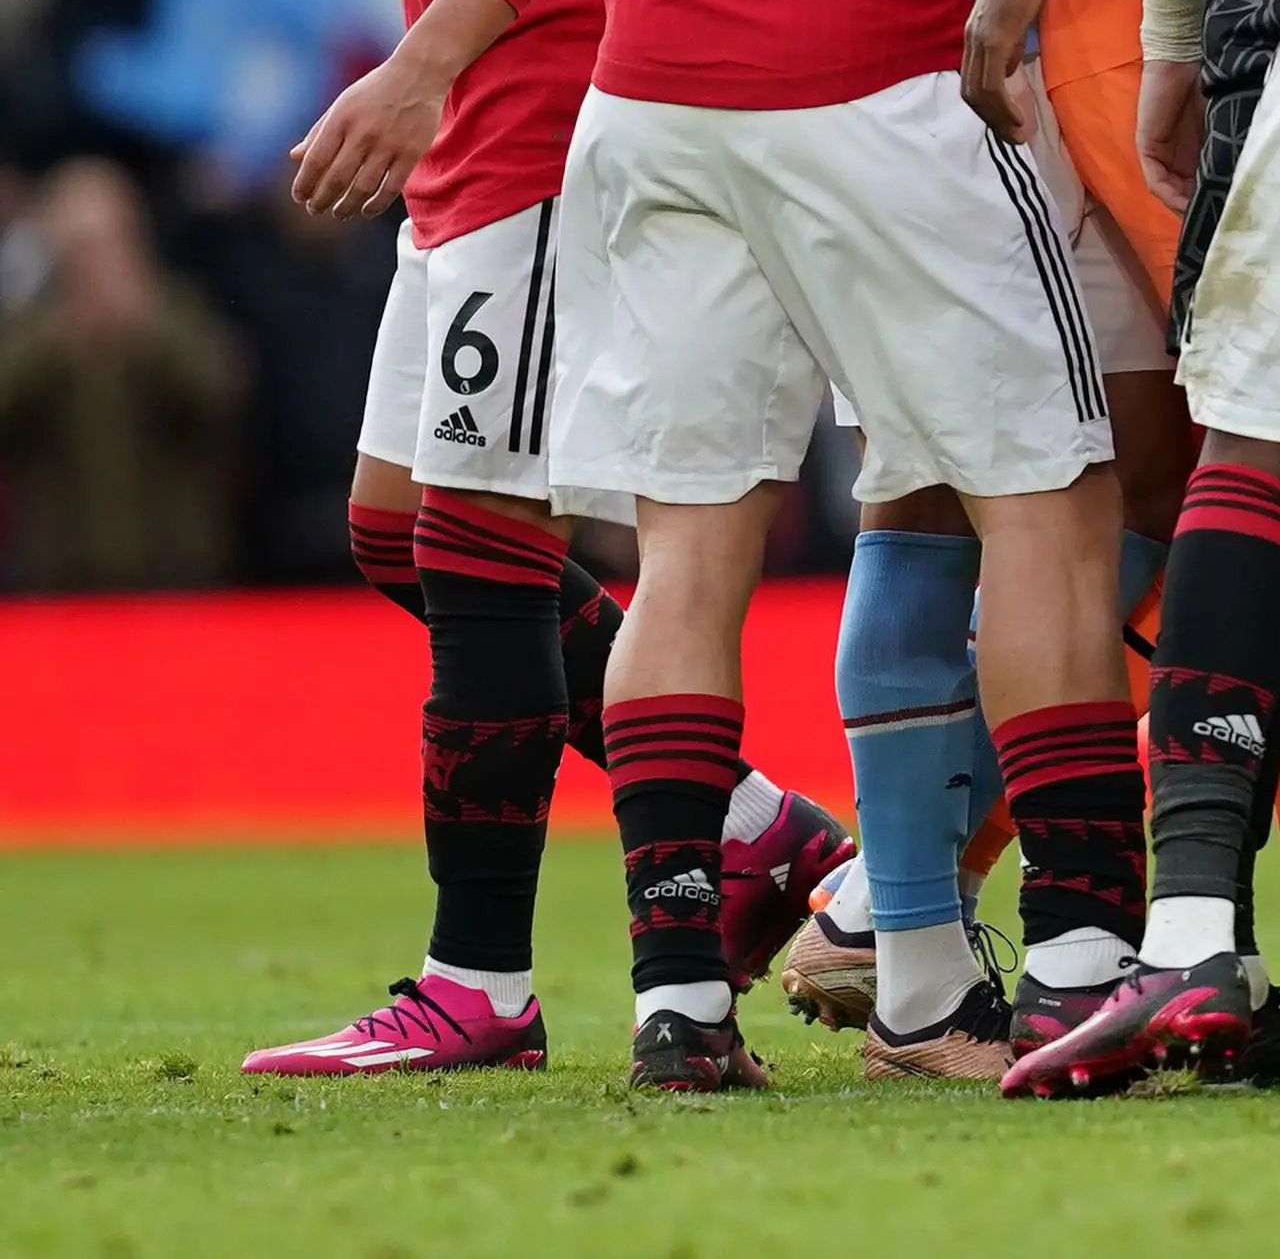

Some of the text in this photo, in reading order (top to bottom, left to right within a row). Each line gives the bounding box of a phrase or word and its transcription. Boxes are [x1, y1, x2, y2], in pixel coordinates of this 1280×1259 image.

[441, 291, 499, 396] 6
[434, 426, 487, 448] adidas
[644, 882, 721, 906] adidas
